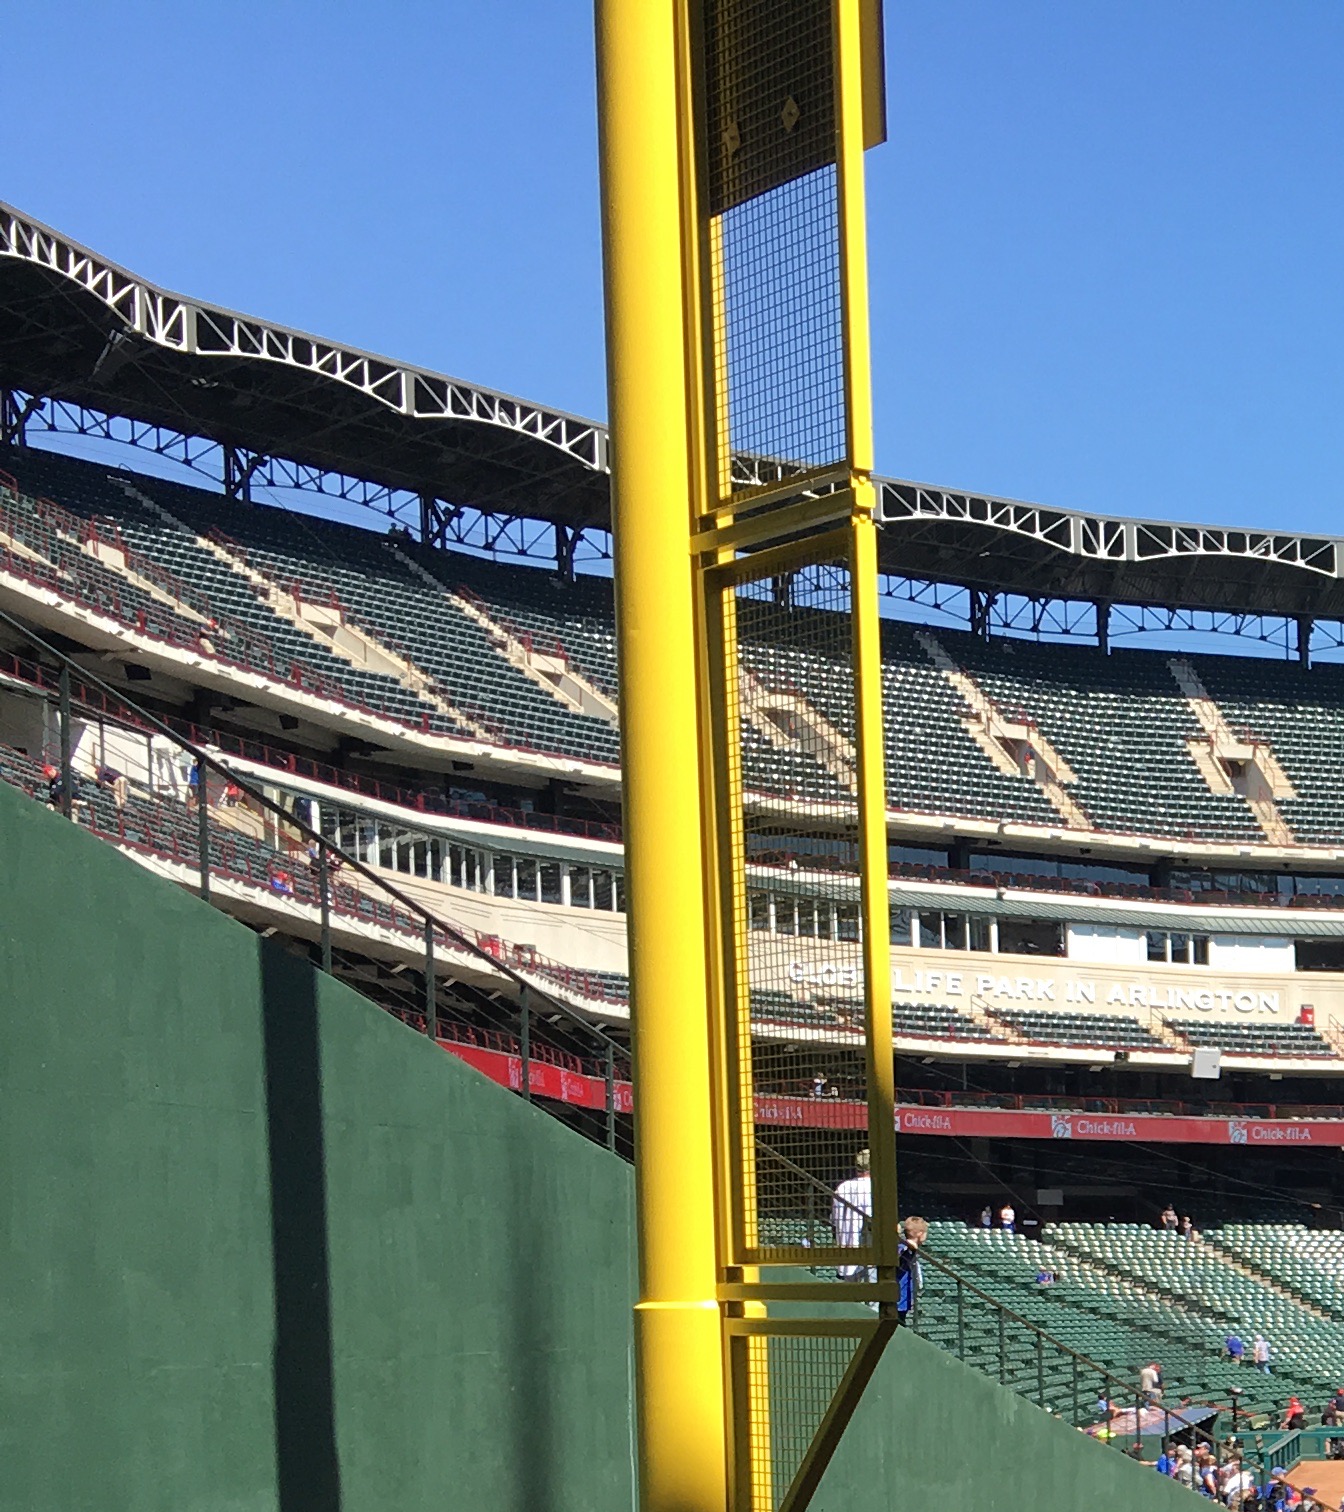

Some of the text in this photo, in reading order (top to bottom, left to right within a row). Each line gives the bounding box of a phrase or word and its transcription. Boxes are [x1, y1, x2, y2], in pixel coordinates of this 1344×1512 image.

[893, 967, 965, 996] LIFE
[976, 974, 1057, 1003] PARK
[1064, 980, 1096, 1006] IN
[1107, 982, 1281, 1014] ARLINGTON
[1077, 1119, 1136, 1136] Chick-fil-A
[1252, 1125, 1311, 1141] Chick-fil-A
